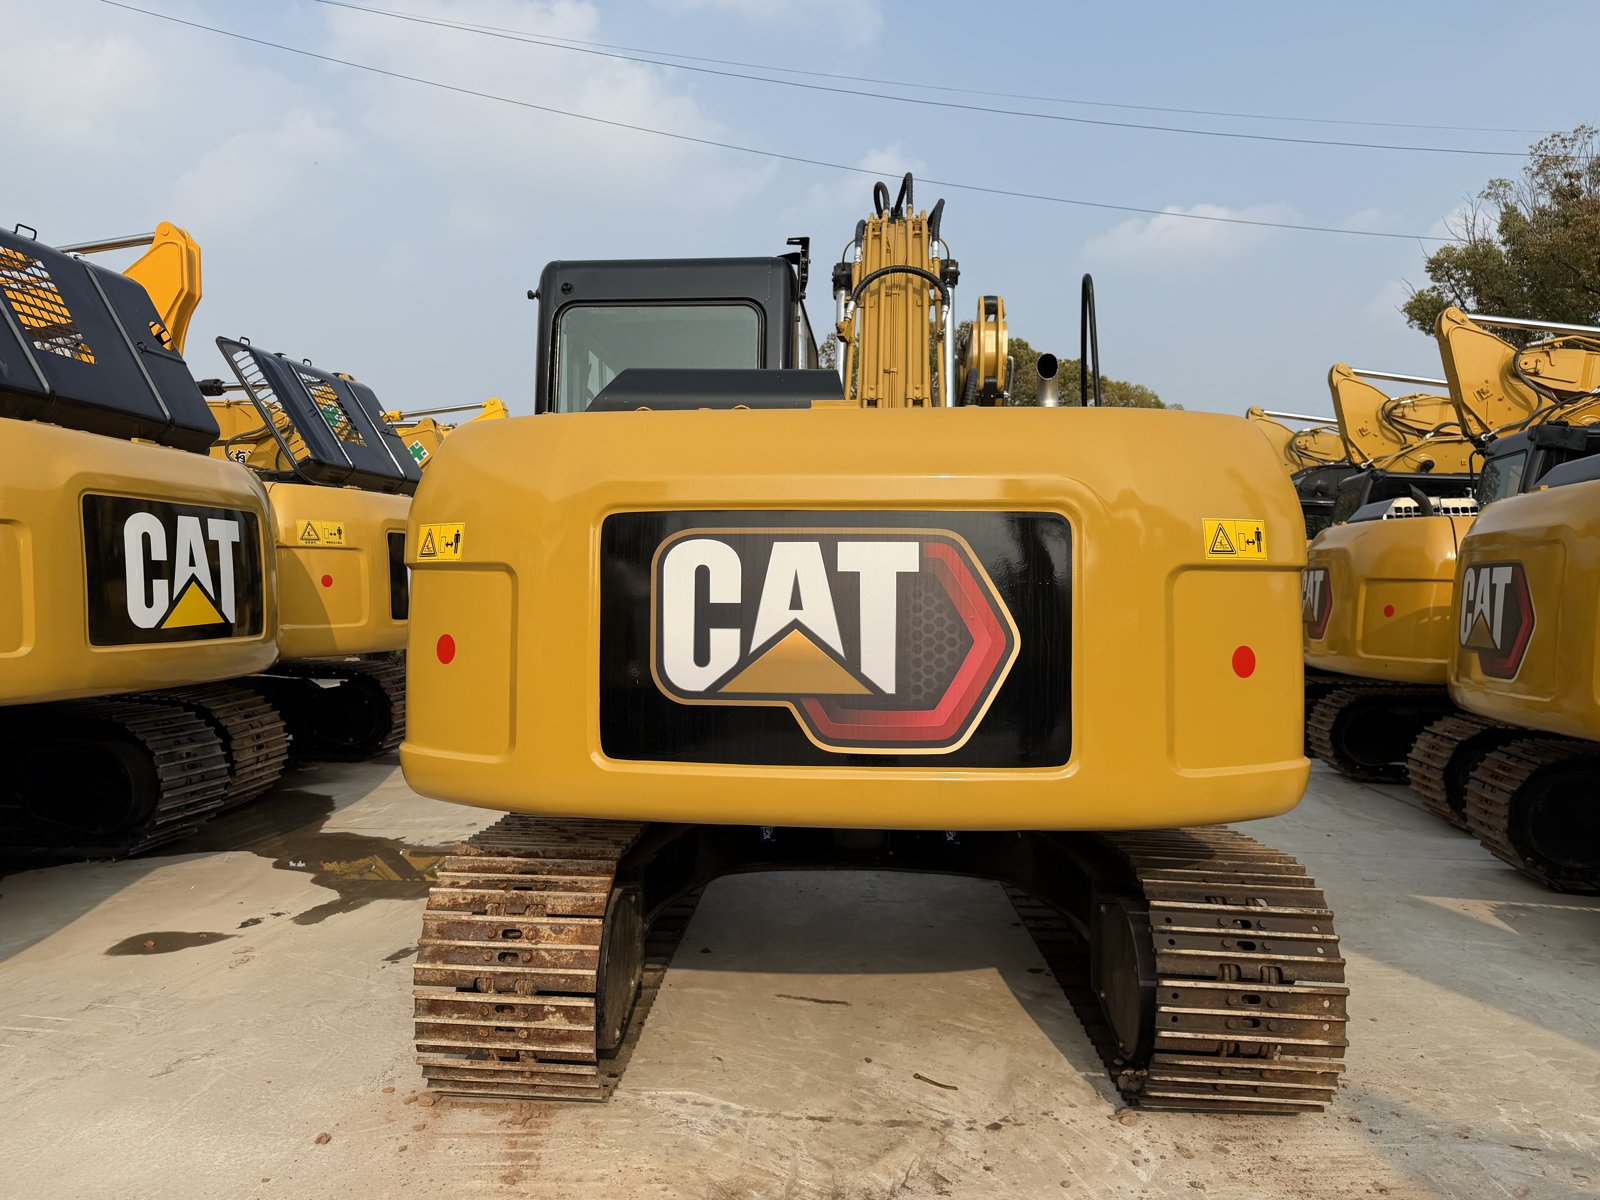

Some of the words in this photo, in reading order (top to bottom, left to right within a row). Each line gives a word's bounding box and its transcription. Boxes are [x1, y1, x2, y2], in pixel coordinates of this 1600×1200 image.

[124, 512, 240, 628] CAT
[663, 539, 919, 694] CAT
[1460, 566, 1513, 650] CAT
